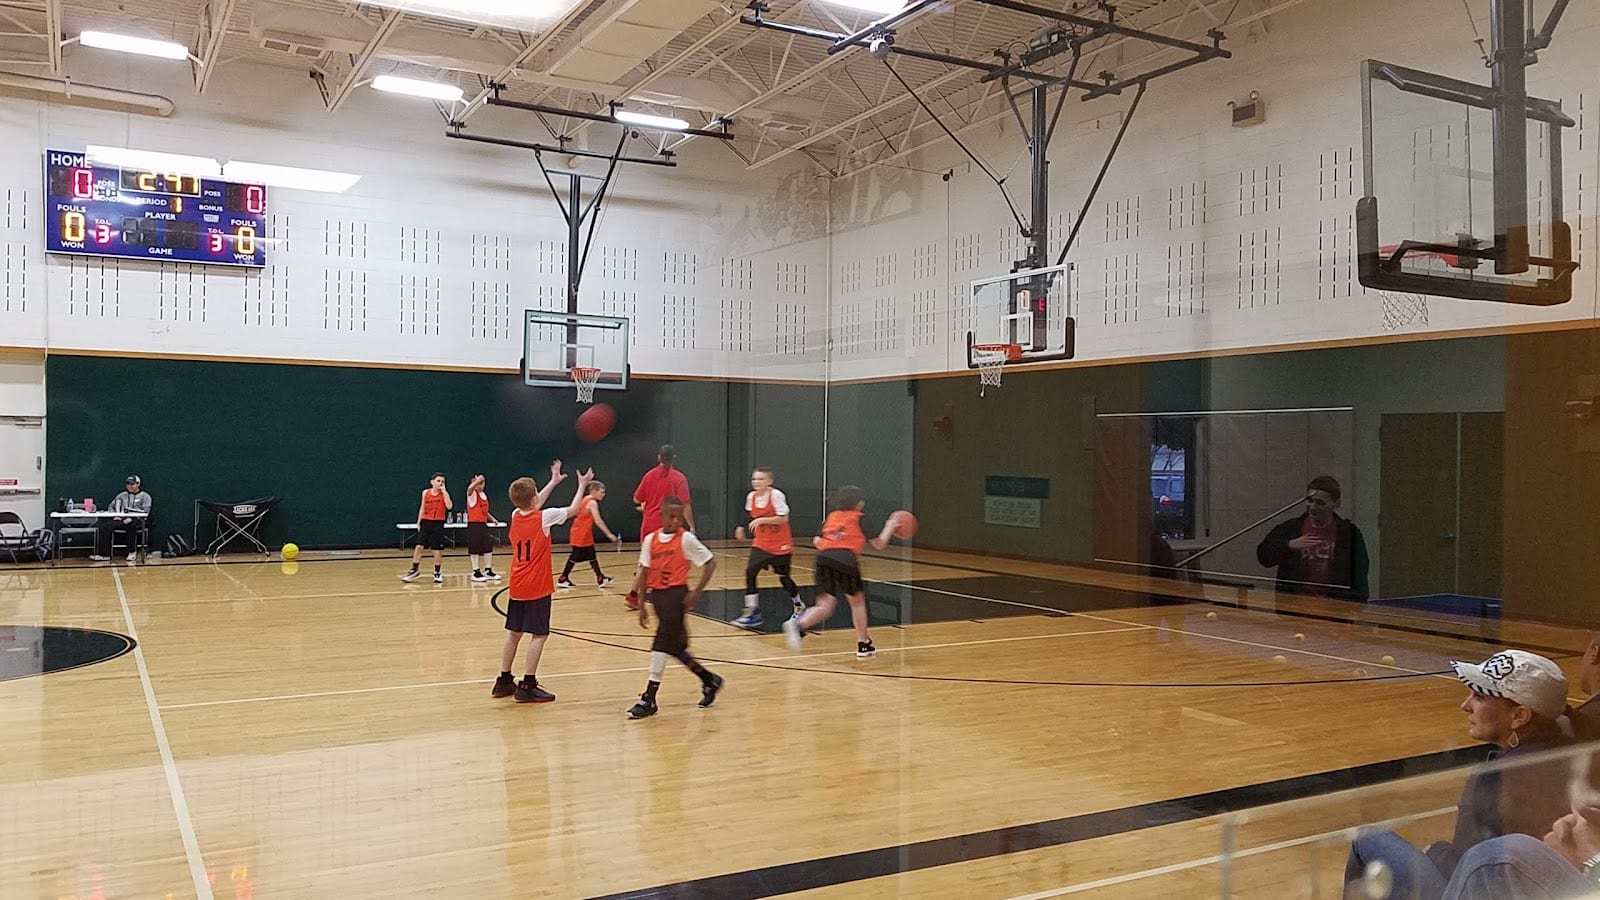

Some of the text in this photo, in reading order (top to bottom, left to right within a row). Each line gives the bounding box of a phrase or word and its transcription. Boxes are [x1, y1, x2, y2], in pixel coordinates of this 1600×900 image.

[51, 153, 92, 168] HOME
[75, 169, 92, 198] 0
[204, 190, 221, 198] POSS
[136, 197, 168, 206] PERIOD
[247, 186, 263, 213] 0
[57, 204, 87, 213] FOULS
[198, 204, 224, 212] BONUS
[144, 211, 177, 221] PLAYER
[65, 212, 85, 242] 0
[231, 218, 257, 228] FOULS
[98, 224, 110, 243] 3
[60, 240, 85, 249] WON
[211, 234, 222, 252] 3
[237, 227, 256, 254] 0
[148, 247, 174, 256] GAME
[233, 253, 255, 261] WON
[516, 539, 531, 563] 11
